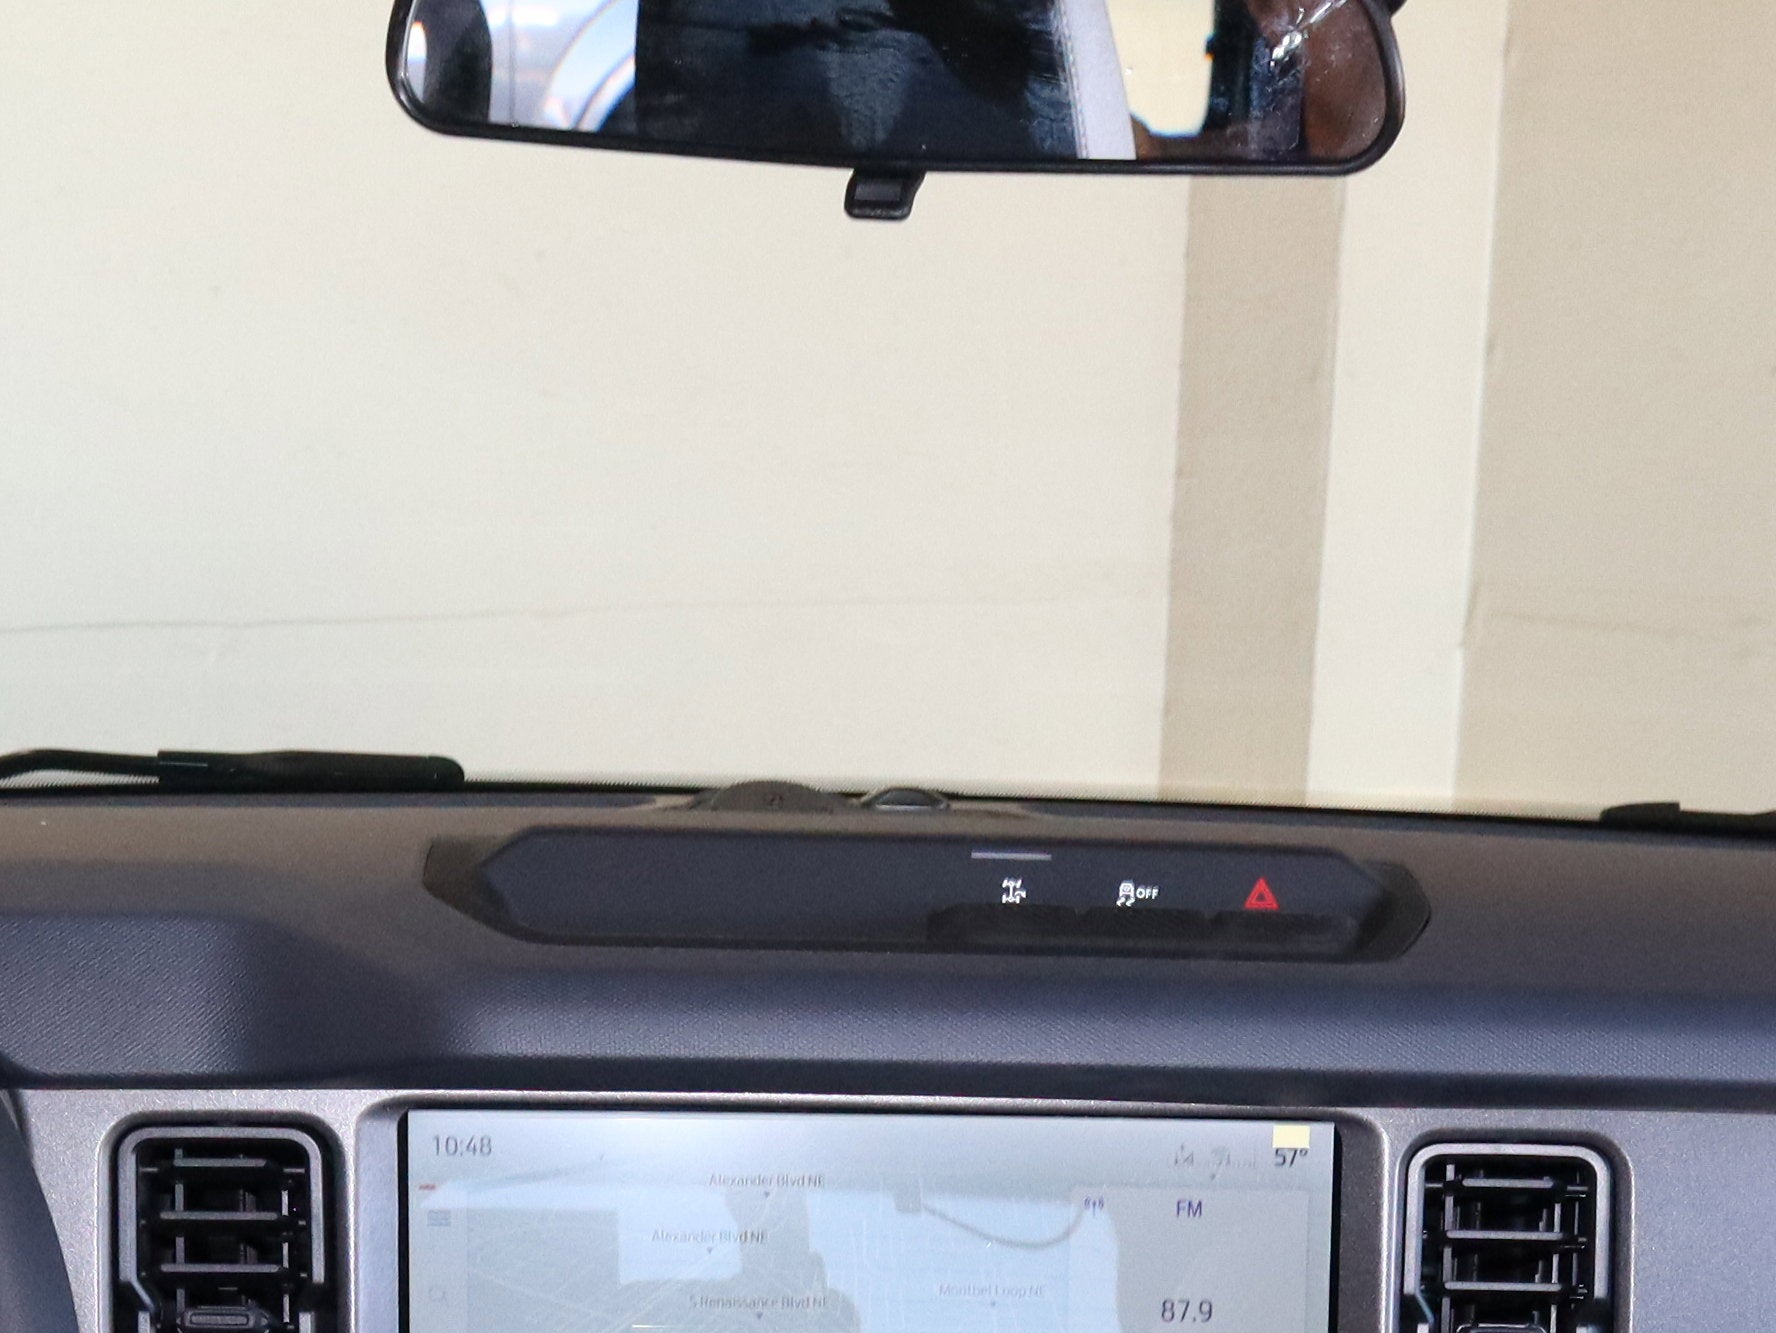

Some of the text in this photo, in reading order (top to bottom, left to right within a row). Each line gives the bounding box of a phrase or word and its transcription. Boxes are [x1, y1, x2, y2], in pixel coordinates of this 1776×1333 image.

[1136, 885, 1159, 900] OFF
[432, 1135, 492, 1157] 10:48
[1176, 1201, 1203, 1217] FM
[1161, 1300, 1213, 1322] 87.9
